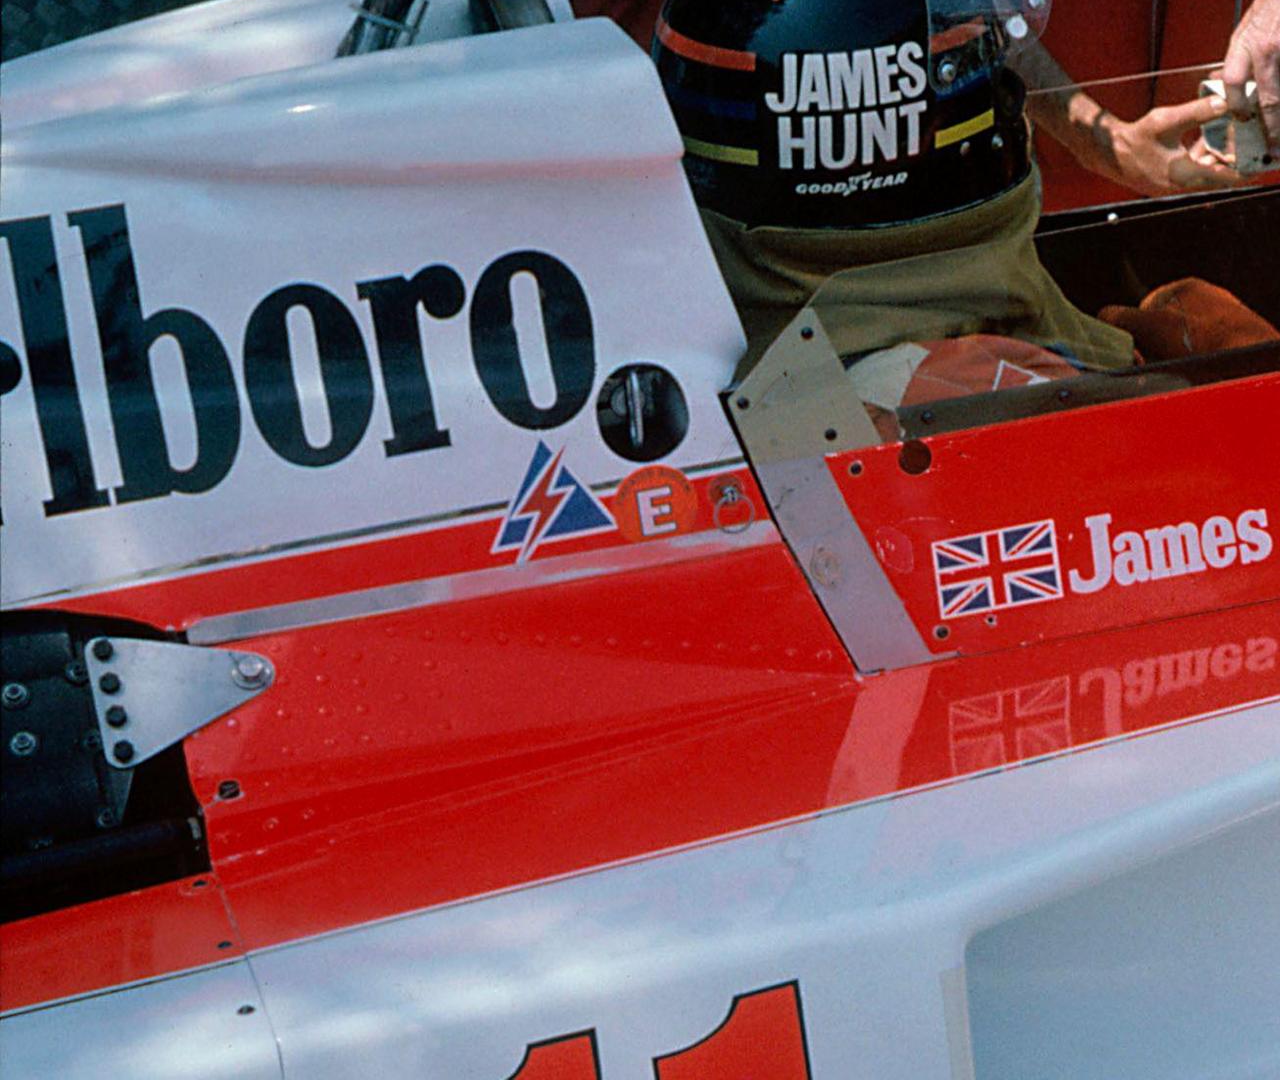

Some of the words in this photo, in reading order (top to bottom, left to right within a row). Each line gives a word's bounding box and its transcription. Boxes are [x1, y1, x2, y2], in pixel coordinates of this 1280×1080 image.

[764, 40, 927, 113] JAMES
[777, 100, 927, 170] HUNT
[0, 204, 596, 522] lboro
[637, 486, 677, 536] E
[1068, 508, 1273, 594] James
